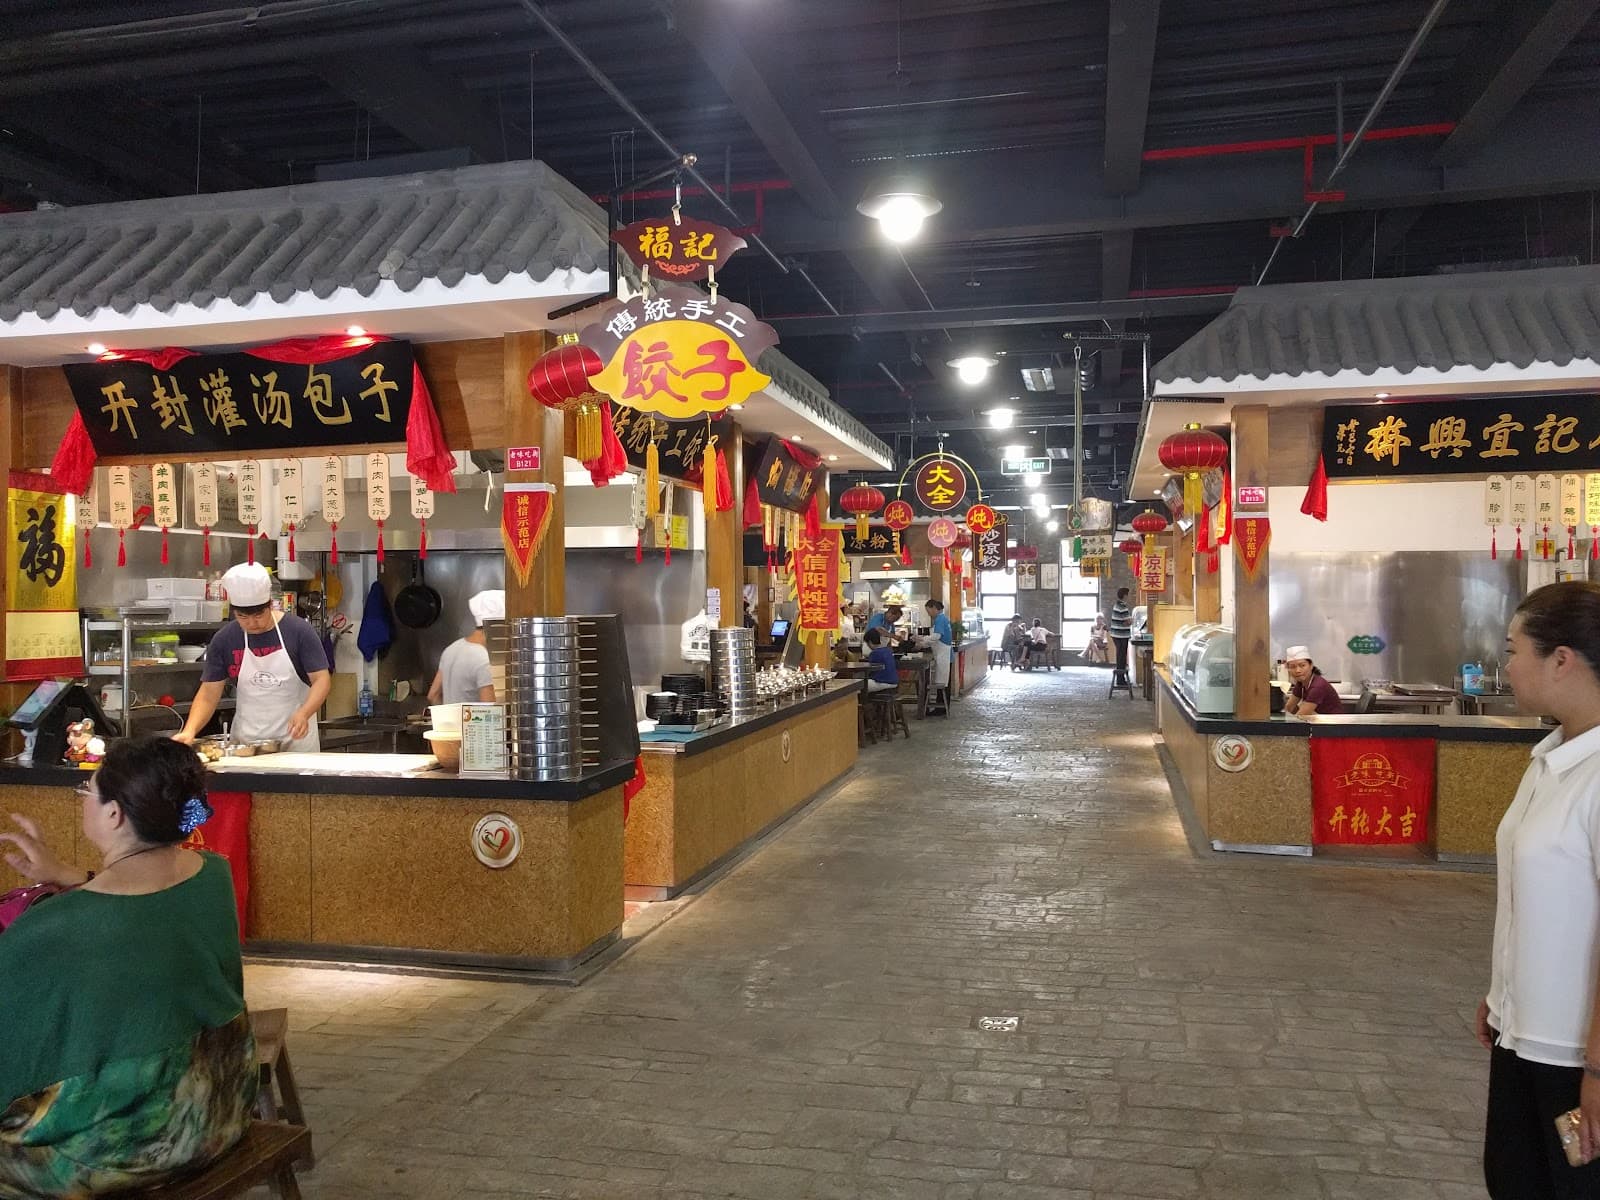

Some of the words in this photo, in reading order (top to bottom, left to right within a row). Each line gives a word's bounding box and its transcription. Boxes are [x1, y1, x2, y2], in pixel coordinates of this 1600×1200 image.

[639, 226, 718, 260] 福記
[605, 297, 747, 340] 傳統手工
[100, 362, 399, 440] 开封灌汤包子
[371, 456, 385, 507] 牛肉大葱
[925, 465, 956, 505] 大全
[516, 494, 530, 549] 诚信示范店
[970, 510, 993, 530] 炖
[18, 504, 66, 588] 福
[802, 553, 830, 625] 信阳炖菜
[1143, 554, 1162, 588] 凉菜
